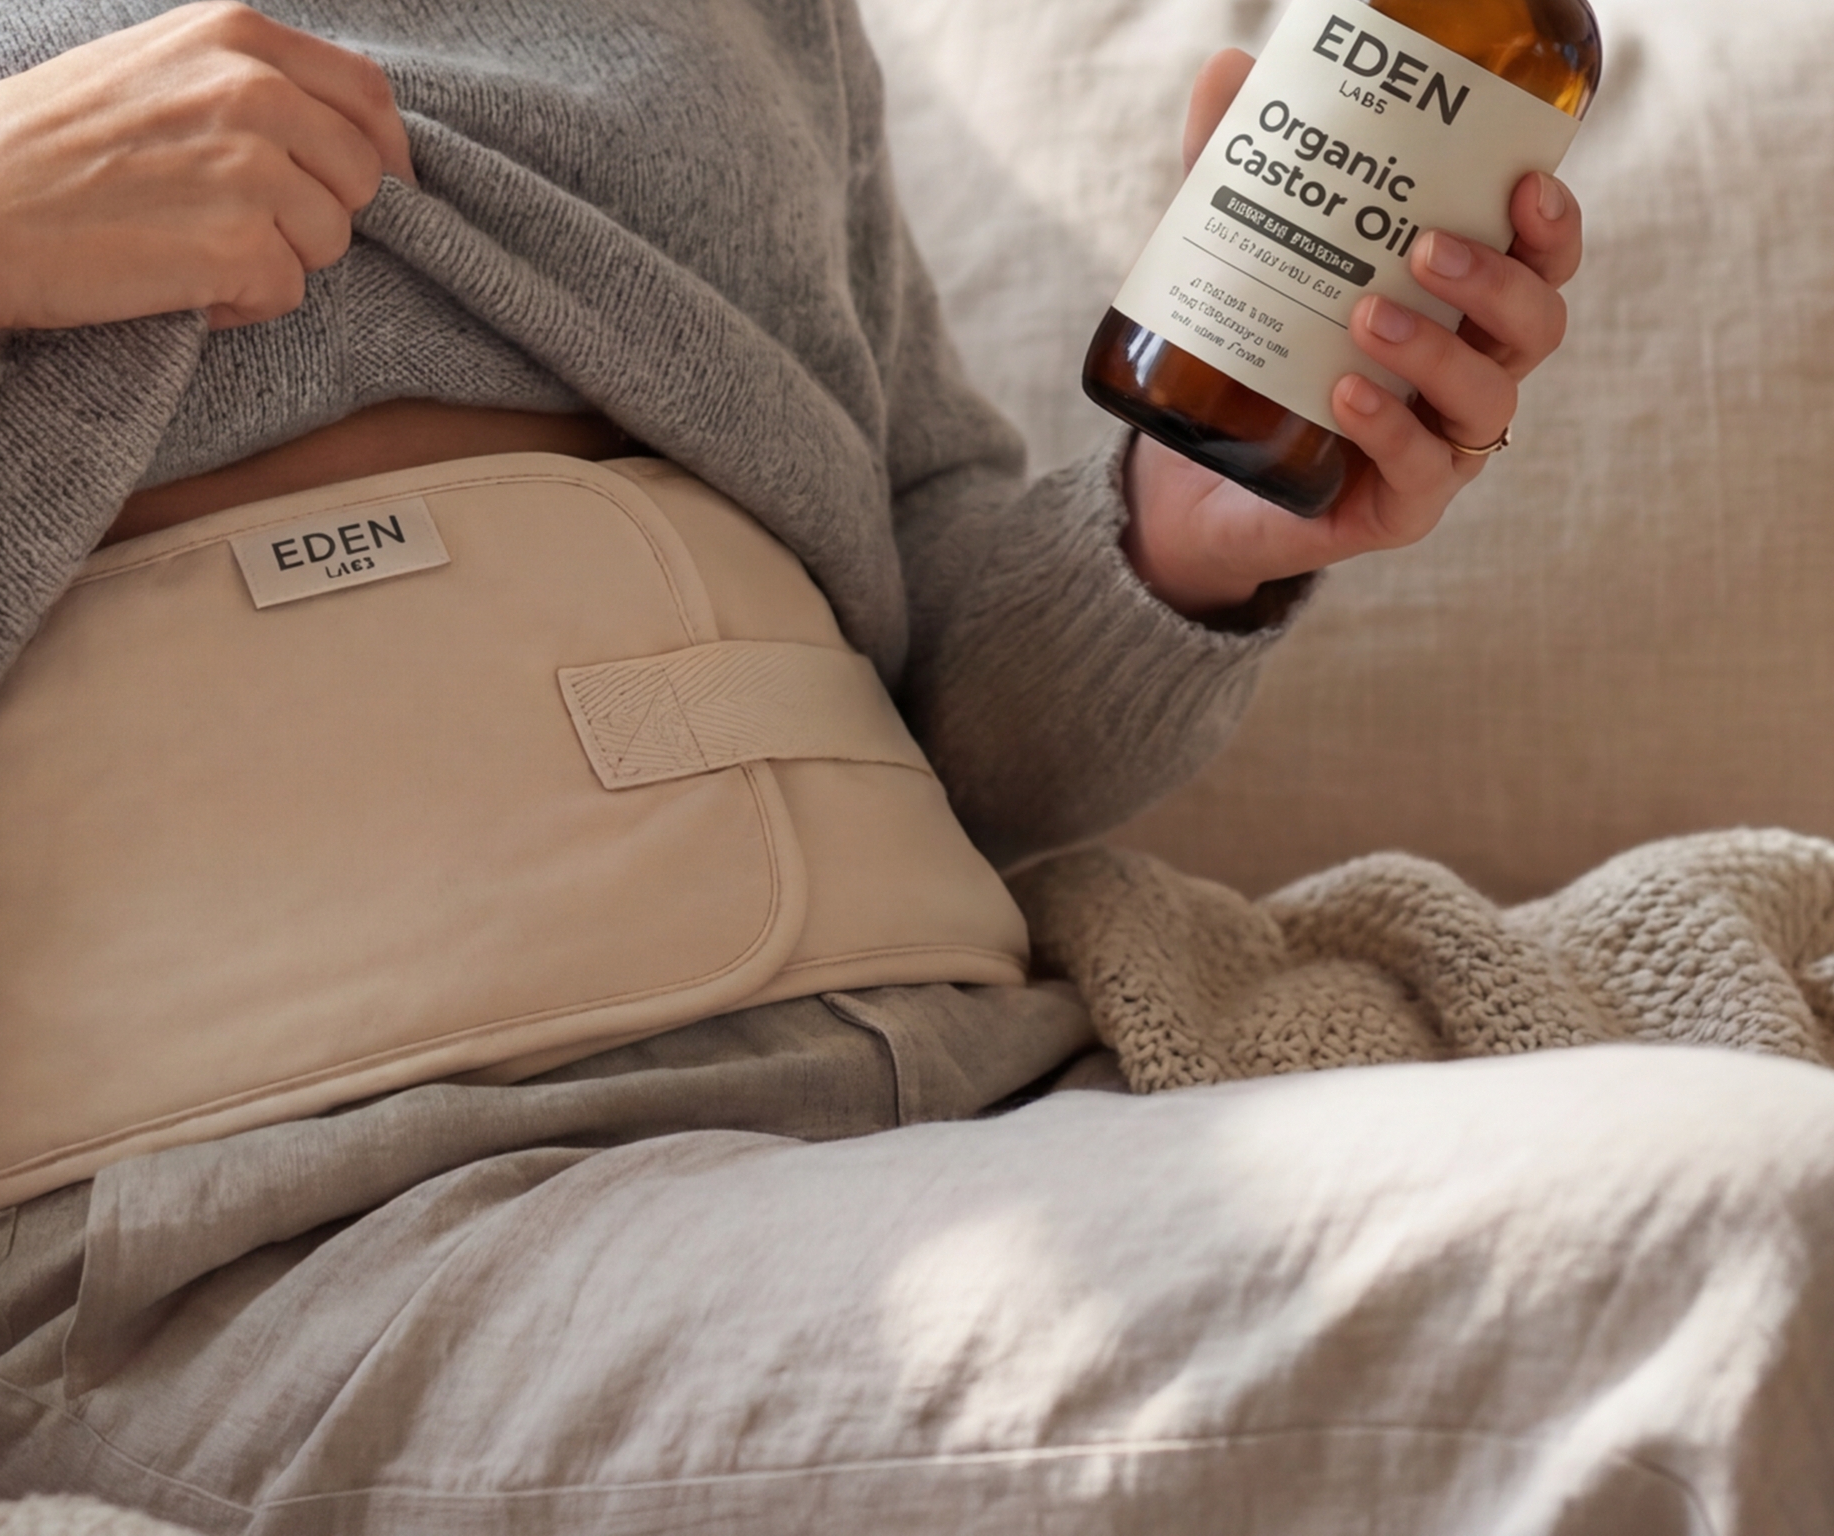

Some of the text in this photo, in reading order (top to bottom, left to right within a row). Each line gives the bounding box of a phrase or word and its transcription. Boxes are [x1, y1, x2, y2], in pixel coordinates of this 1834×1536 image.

[1312, 14, 1471, 126] EDEN
[1338, 80, 1388, 115] LABS
[1225, 133, 1348, 217] Castor
[1355, 205, 1420, 258] Oil
[1259, 100, 1416, 202] Organic
[271, 515, 406, 571] EDEN
